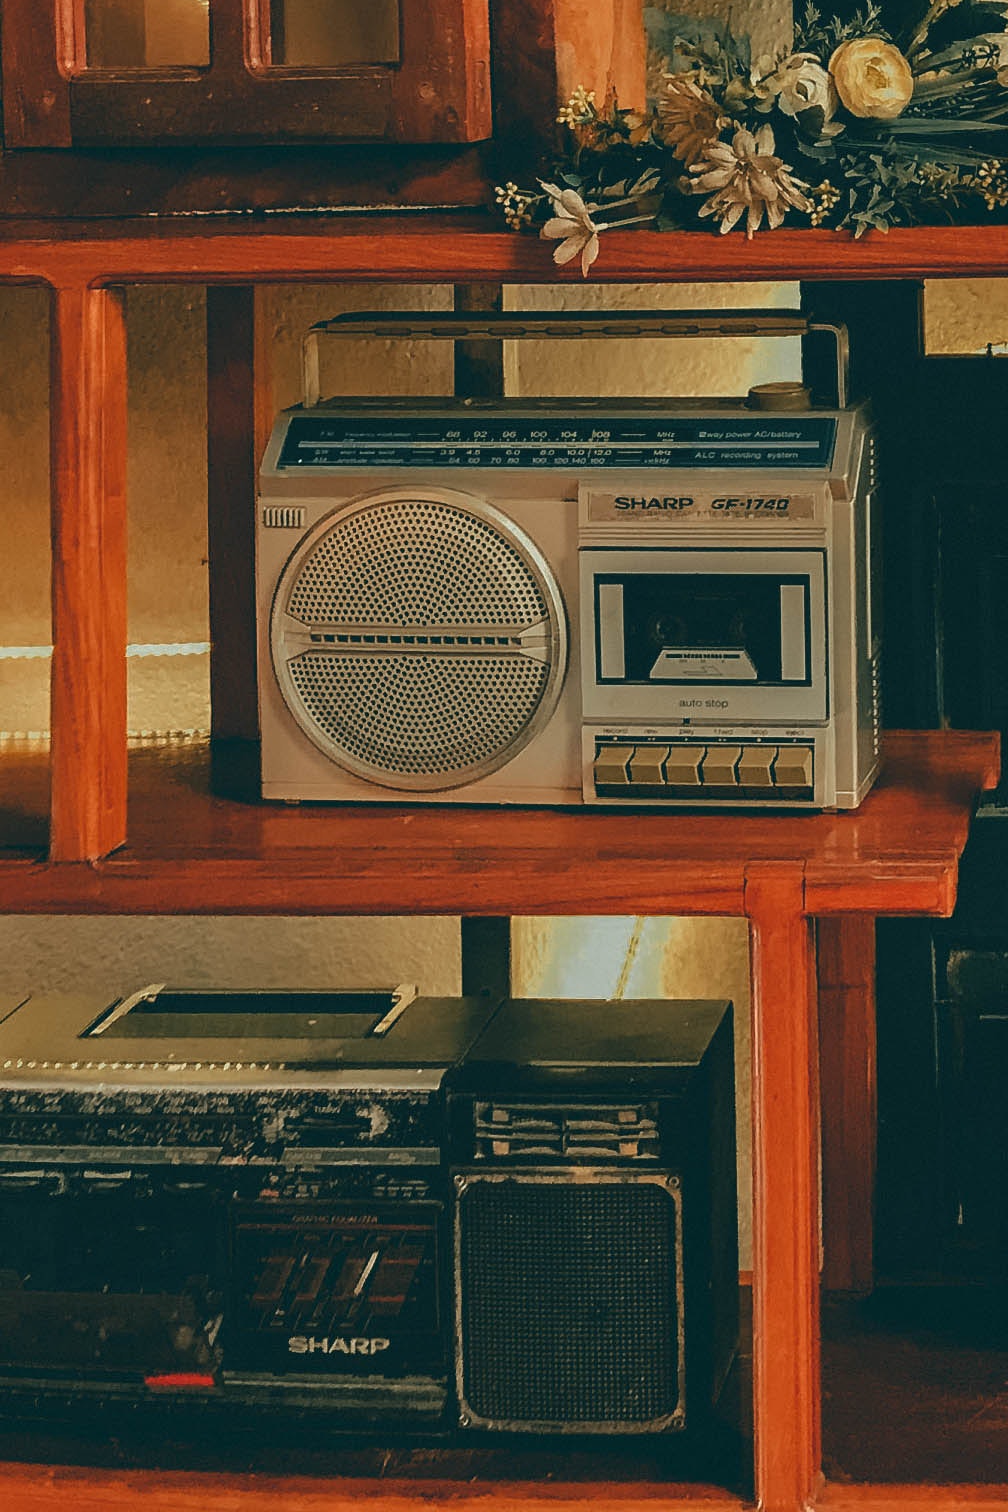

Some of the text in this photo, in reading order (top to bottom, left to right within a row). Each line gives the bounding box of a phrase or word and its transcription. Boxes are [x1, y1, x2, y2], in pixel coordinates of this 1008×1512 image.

[694, 451, 799, 460] ALC recording system
[614, 496, 790, 511] SHARP GF-1740
[679, 698, 729, 710] auto stop
[288, 1336, 391, 1355] SHARP
